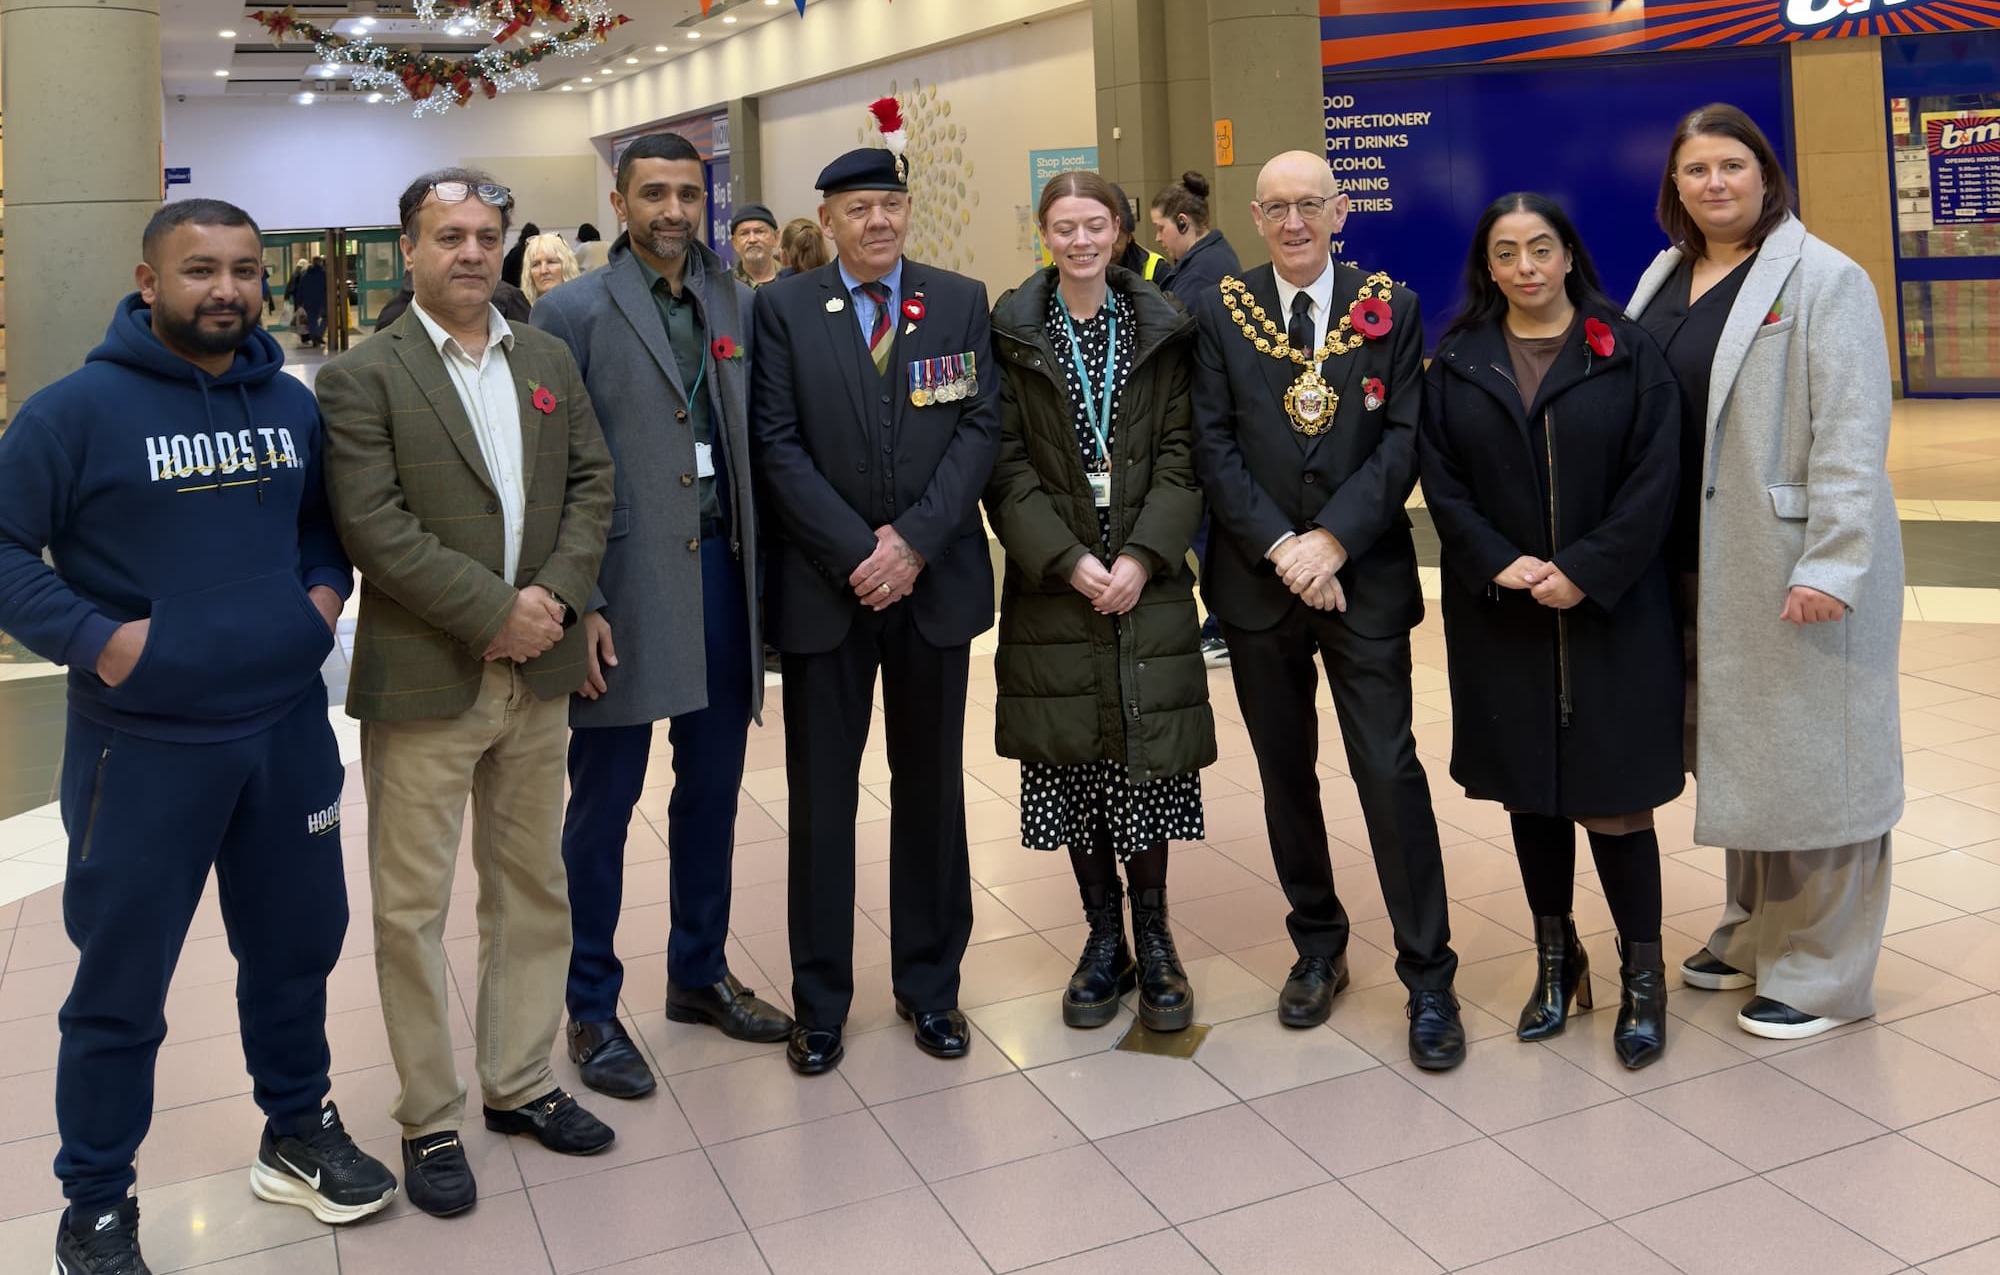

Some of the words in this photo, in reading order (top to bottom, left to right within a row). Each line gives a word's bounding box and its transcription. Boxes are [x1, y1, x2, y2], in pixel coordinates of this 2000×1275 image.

[1323, 95, 1354, 109] OOD
[1325, 112, 1431, 130] ONFECTIONERY
[1325, 136, 1351, 151] OFT
[1354, 134, 1409, 150] DRINKS
[1037, 157, 1059, 168] Shop
[1327, 156, 1386, 172] LCOHOL
[1336, 177, 1390, 192] EANING
[713, 182, 726, 208] Big
[1348, 198, 1393, 213] ETRIES
[713, 220, 726, 246] Big
[1331, 241, 1345, 254] IY
[146, 427, 300, 482] HOODSTA
